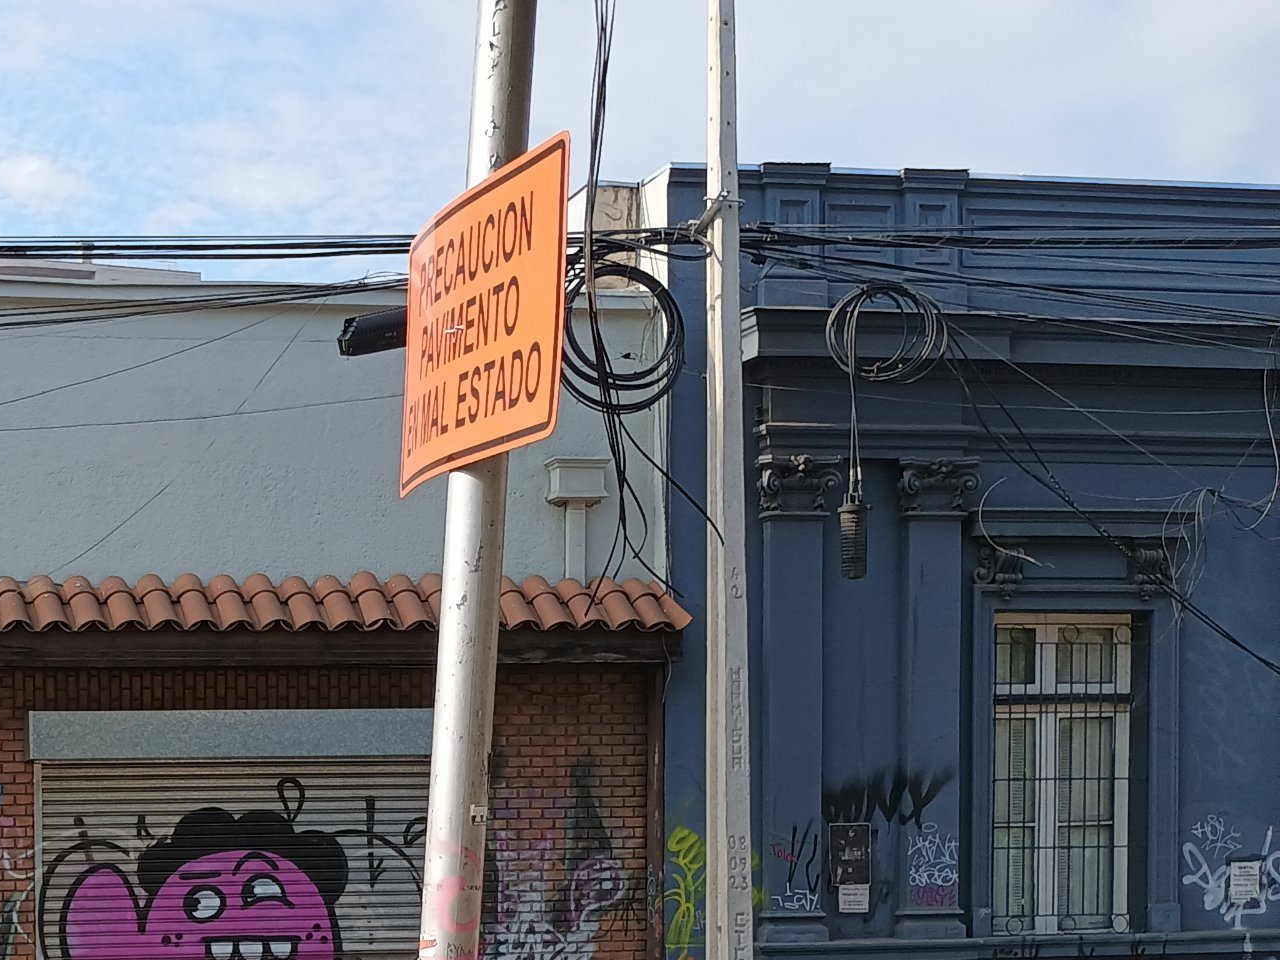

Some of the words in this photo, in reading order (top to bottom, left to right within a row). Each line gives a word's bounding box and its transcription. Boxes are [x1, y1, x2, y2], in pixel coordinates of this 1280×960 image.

[418, 190, 535, 317] PRECAUCION
[418, 275, 521, 382] PAVIMENTO
[406, 401, 420, 460] EN
[420, 381, 450, 447] MAL
[454, 340, 542, 430] ESTADO
[728, 834, 747, 851] 08
[729, 856, 747, 872] 09
[728, 875, 749, 891] 23
